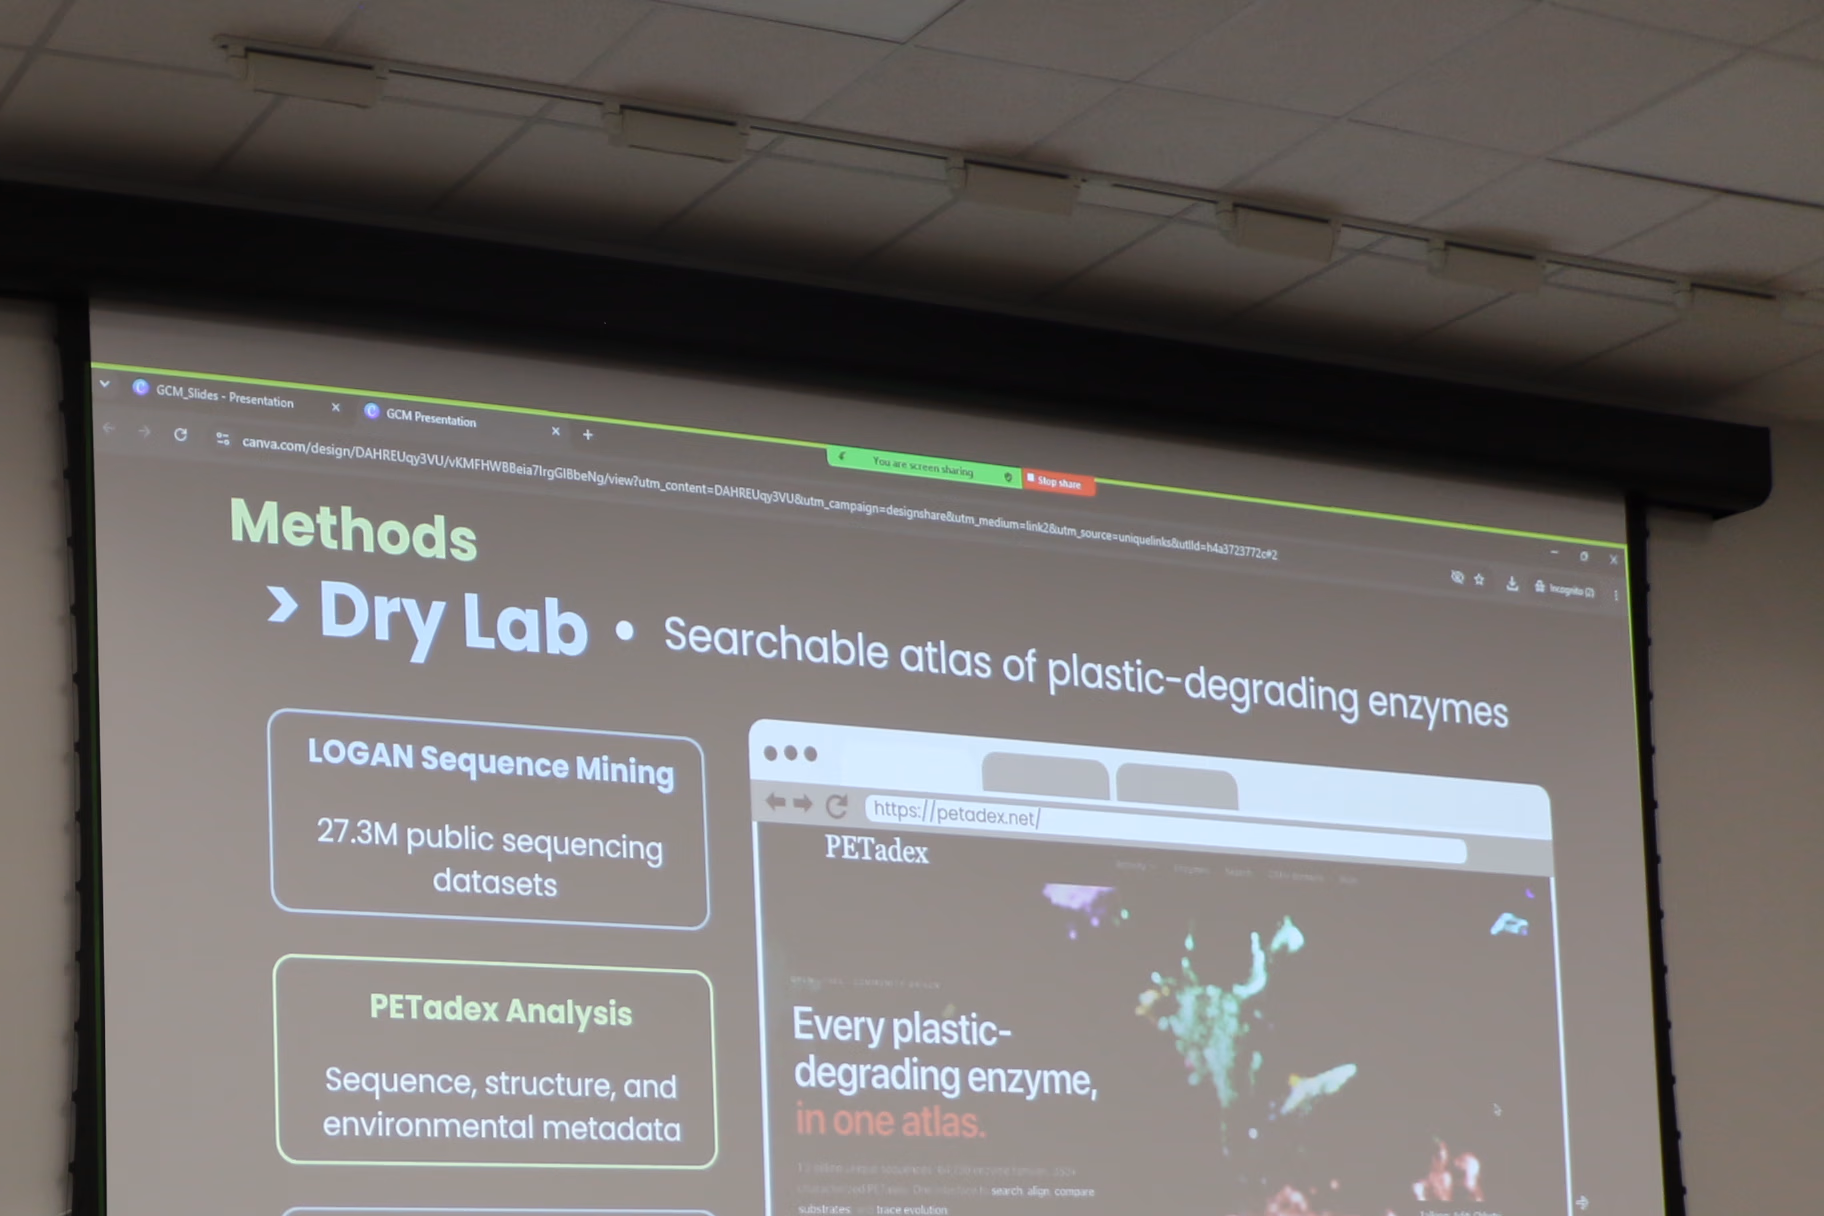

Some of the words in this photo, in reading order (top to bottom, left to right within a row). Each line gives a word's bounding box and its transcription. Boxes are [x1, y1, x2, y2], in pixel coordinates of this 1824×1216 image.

[156, 384, 218, 401] GCM_Slides
[229, 391, 294, 409] Presentation
[386, 408, 412, 421] GCM
[414, 411, 477, 427] Presentation
[873, 455, 891, 468] You
[893, 460, 907, 469] are
[909, 462, 940, 473] screen
[941, 464, 974, 479] sharing
[1037, 475, 1057, 488] Stop
[1059, 477, 1082, 490] share
[230, 497, 478, 562] Methods
[320, 580, 446, 664] Dry
[464, 592, 589, 657] Lab
[664, 616, 889, 670] Searchable
[900, 638, 992, 680] atlas
[1002, 648, 1039, 684] of
[1047, 652, 1360, 725] plastic-degrading
[1368, 688, 1510, 731] enzymes
[308, 737, 414, 770] LOGAN
[420, 744, 570, 781] Sequence
[575, 755, 675, 794] Mining
[873, 798, 1042, 831] https://petadex.net/
[316, 817, 398, 846] 27.3M
[406, 822, 495, 855] public
[502, 828, 664, 868] sequencing
[824, 833, 930, 864] PETadex
[432, 866, 558, 898] datasets
[370, 992, 500, 1023] PETadex
[505, 997, 633, 1033] Analysis
[792, 1005, 885, 1049] Every
[892, 1009, 1012, 1050] plastic-
[324, 1066, 477, 1100] Sequence,
[484, 1069, 616, 1102] structure,
[623, 1074, 678, 1100] and
[794, 1053, 961, 1099] degrading
[967, 1065, 1099, 1101] enzyme,
[322, 1109, 535, 1140] environmental
[542, 1114, 682, 1143] metadata
[795, 1100, 827, 1135] in
[832, 1106, 896, 1136] one
[901, 1103, 987, 1139] atlas.
[991, 1185, 1023, 1197] search
[1027, 1185, 1050, 1199] align
[1054, 1187, 1095, 1199] compare
[797, 1203, 852, 1215] substrates
[876, 1204, 902, 1215] trace
[903, 1204, 949, 1216] evolution
